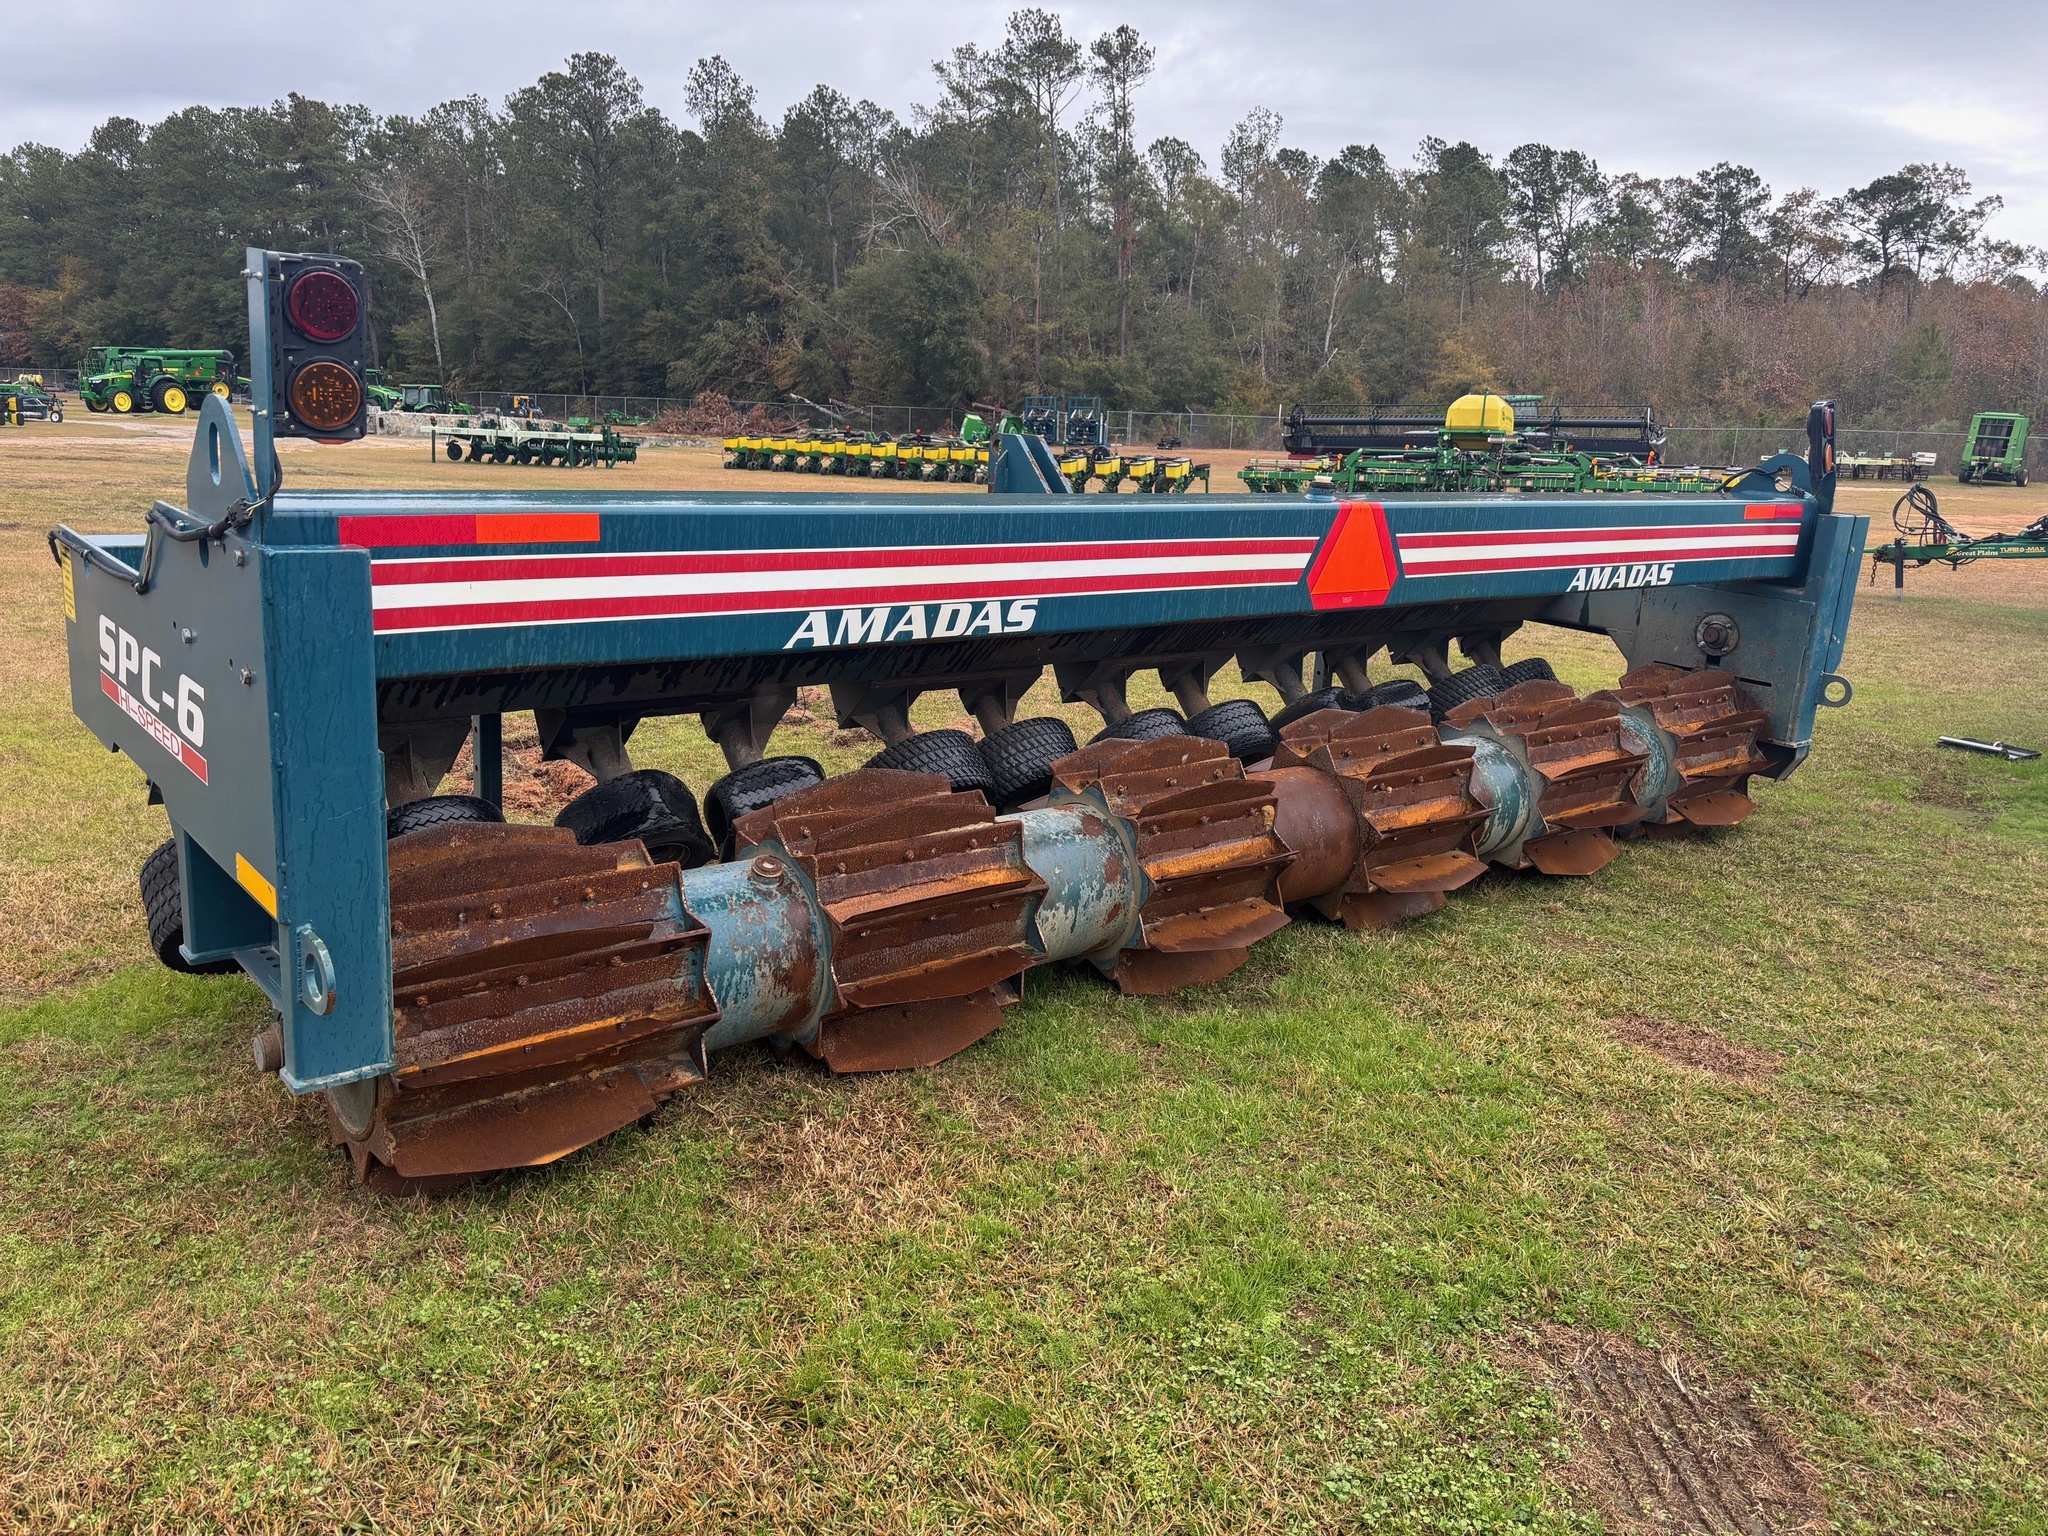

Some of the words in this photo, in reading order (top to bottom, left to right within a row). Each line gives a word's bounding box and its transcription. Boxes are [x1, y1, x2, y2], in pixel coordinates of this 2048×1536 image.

[1565, 563, 1676, 593] AMADAS
[1977, 549, 1999, 557] Plains
[782, 599, 1039, 650] AMADAS
[99, 614, 205, 748] SPC-6
[118, 691, 181, 758] HI-SPEED
